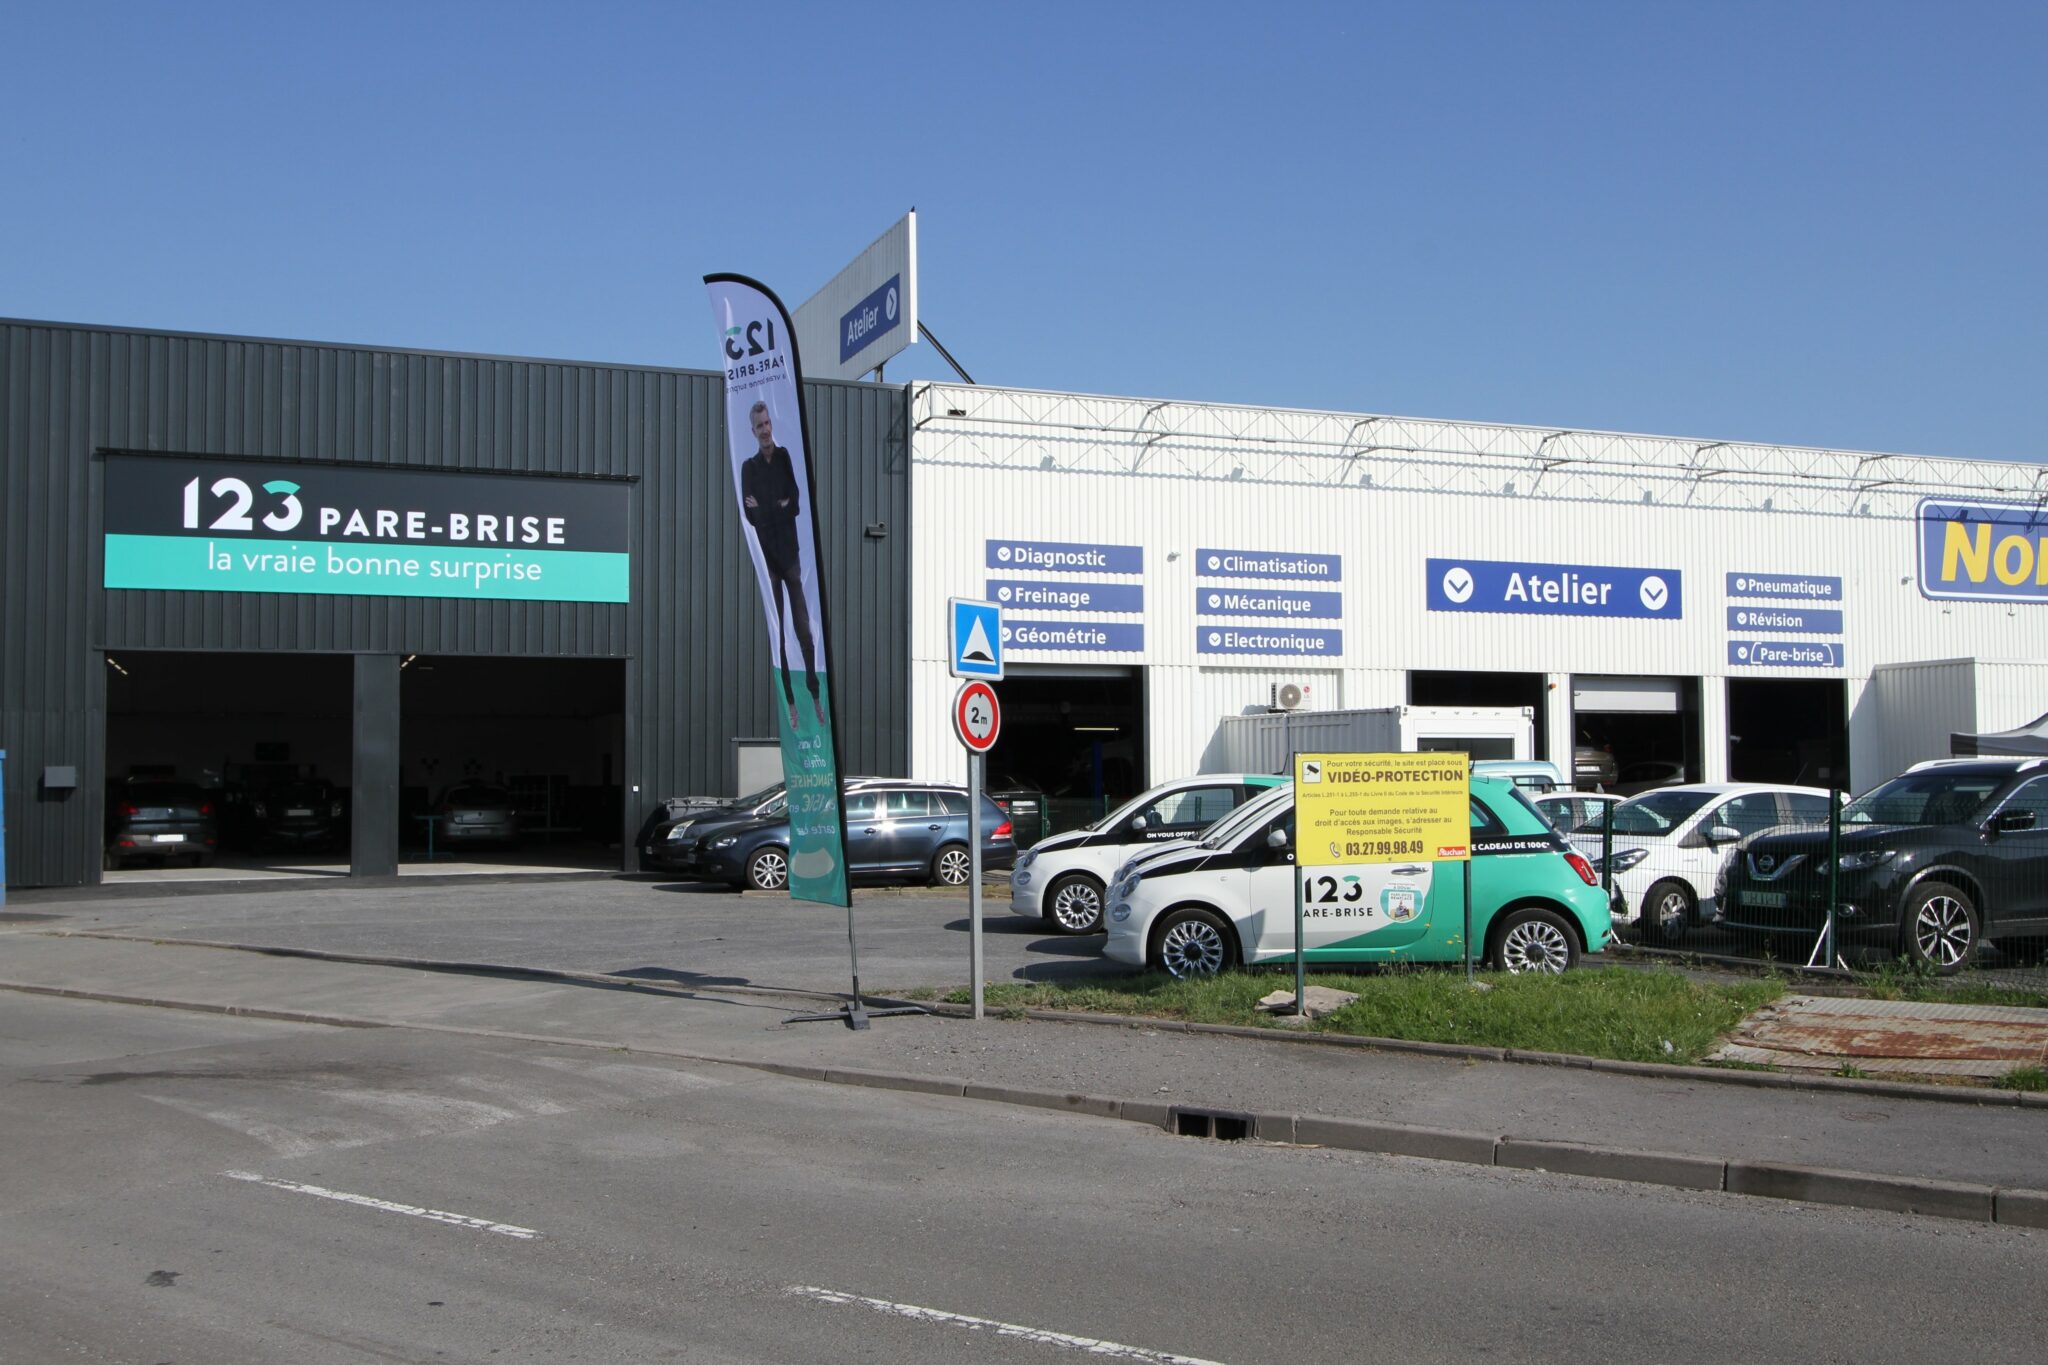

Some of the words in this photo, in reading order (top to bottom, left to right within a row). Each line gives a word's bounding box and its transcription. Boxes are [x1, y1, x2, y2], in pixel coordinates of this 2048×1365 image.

[846, 305, 879, 346] Atelier
[183, 476, 303, 532] 123
[320, 507, 565, 545] PARE-BRISE
[208, 541, 232, 571] la
[242, 545, 317, 573] vraie
[327, 545, 420, 577] bonne
[429, 552, 542, 590] surprise
[1014, 547, 1107, 568] Diagnostic
[1223, 556, 1328, 575] Climatisation
[1504, 572, 1612, 605] Atelier
[1748, 578, 1832, 597] Pneumatique
[1015, 587, 1090, 608] Freinage
[1224, 594, 1312, 615] Mécanique
[1749, 612, 1803, 627] Révision
[1015, 626, 1107, 645] Géométrie
[1224, 632, 1325, 652] Electronique
[1760, 647, 1824, 662] Pare-brise
[1428, 759, 1445, 767] placé
[1327, 769, 1463, 783] VIDÉO-PROTECTION
[1368, 808, 1400, 816] demande
[1402, 807, 1428, 815] relative
[1314, 819, 1332, 827] droit
[1346, 827, 1392, 837] Responsable
[1346, 840, 1424, 856] 03.27.99.98.49
[1438, 847, 1466, 856] Auchan
[1478, 842, 1513, 851] CADEAU
[1514, 841, 1526, 849] DE
[1304, 874, 1363, 904] 123
[1302, 907, 1374, 918] ARE-BRISE
